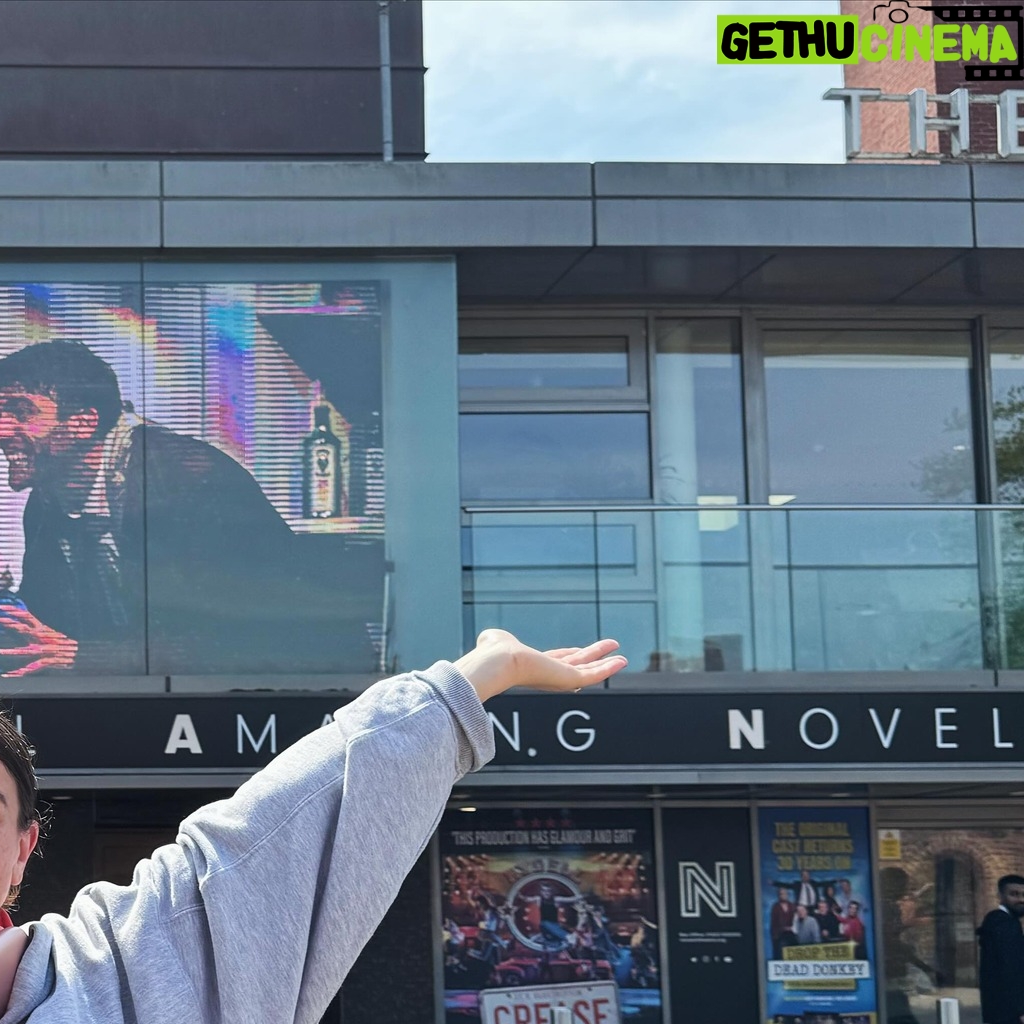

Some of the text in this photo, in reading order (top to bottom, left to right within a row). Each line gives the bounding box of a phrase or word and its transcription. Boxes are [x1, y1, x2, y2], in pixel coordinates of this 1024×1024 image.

[728, 708, 1014, 749] NOVEL
[678, 862, 737, 917] N
[774, 963, 865, 976] DEAD DONKEY
